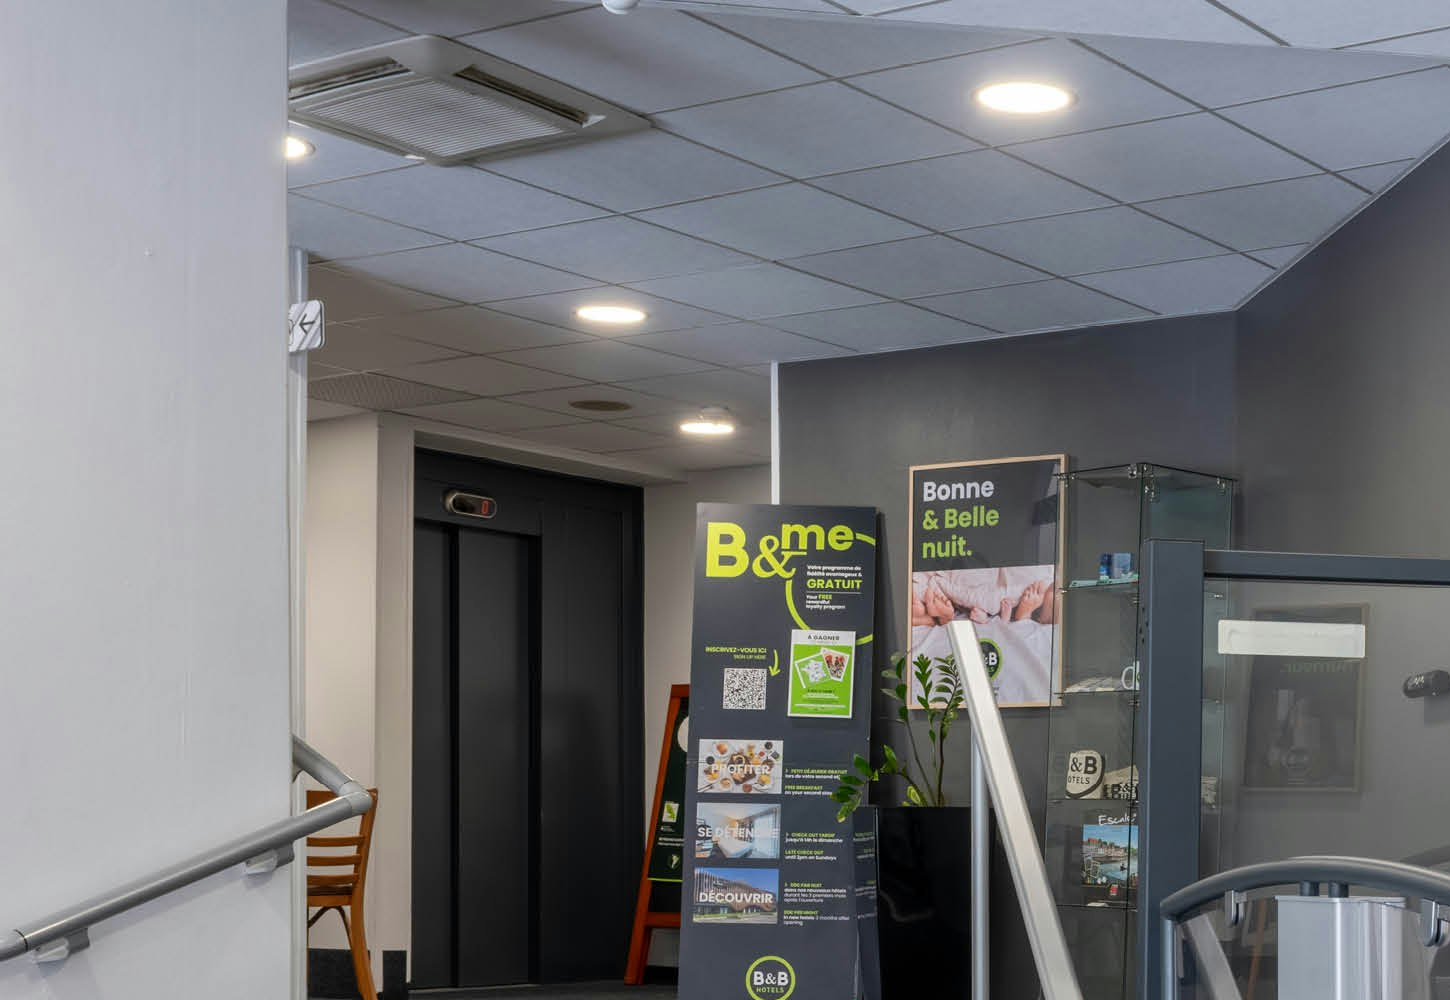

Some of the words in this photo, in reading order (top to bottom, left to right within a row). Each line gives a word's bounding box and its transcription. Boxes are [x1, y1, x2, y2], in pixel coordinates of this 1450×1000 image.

[923, 480, 994, 502] Bonne
[922, 509, 939, 531] &
[944, 505, 1000, 529] Belle
[922, 535, 973, 559] nuit.
[806, 578, 863, 590] GRATUIT
[1070, 755, 1098, 775] &B
[1067, 776, 1090, 785] OTELS
[697, 826, 713, 838] SE
[699, 888, 774, 904] DÉCOUVRIR
[753, 971, 789, 986] B&B
